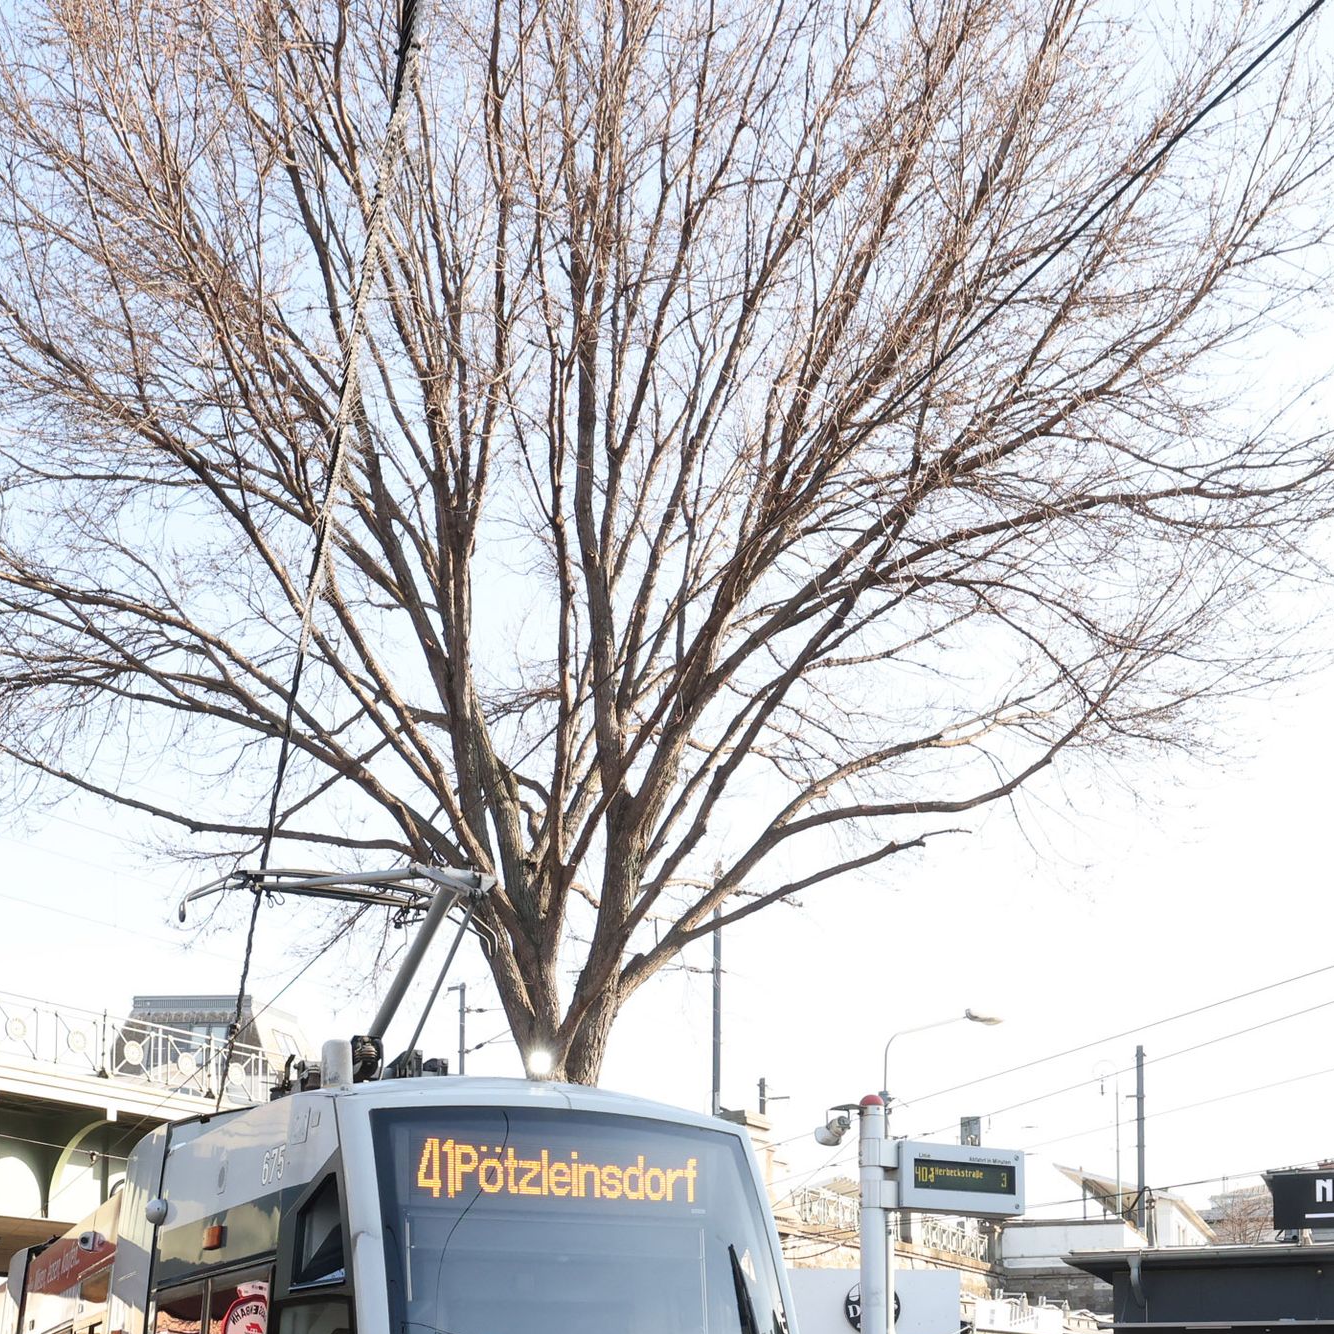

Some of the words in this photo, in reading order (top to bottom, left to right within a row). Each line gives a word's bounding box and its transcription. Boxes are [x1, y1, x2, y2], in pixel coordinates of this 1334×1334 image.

[261, 1145, 286, 1186] 675
[417, 1137, 455, 1198] 41
[455, 1144, 697, 1202] Pötzleinsdorf
[934, 1166, 984, 1179] Herbeckstraße
[1000, 1172, 1007, 1188] 3
